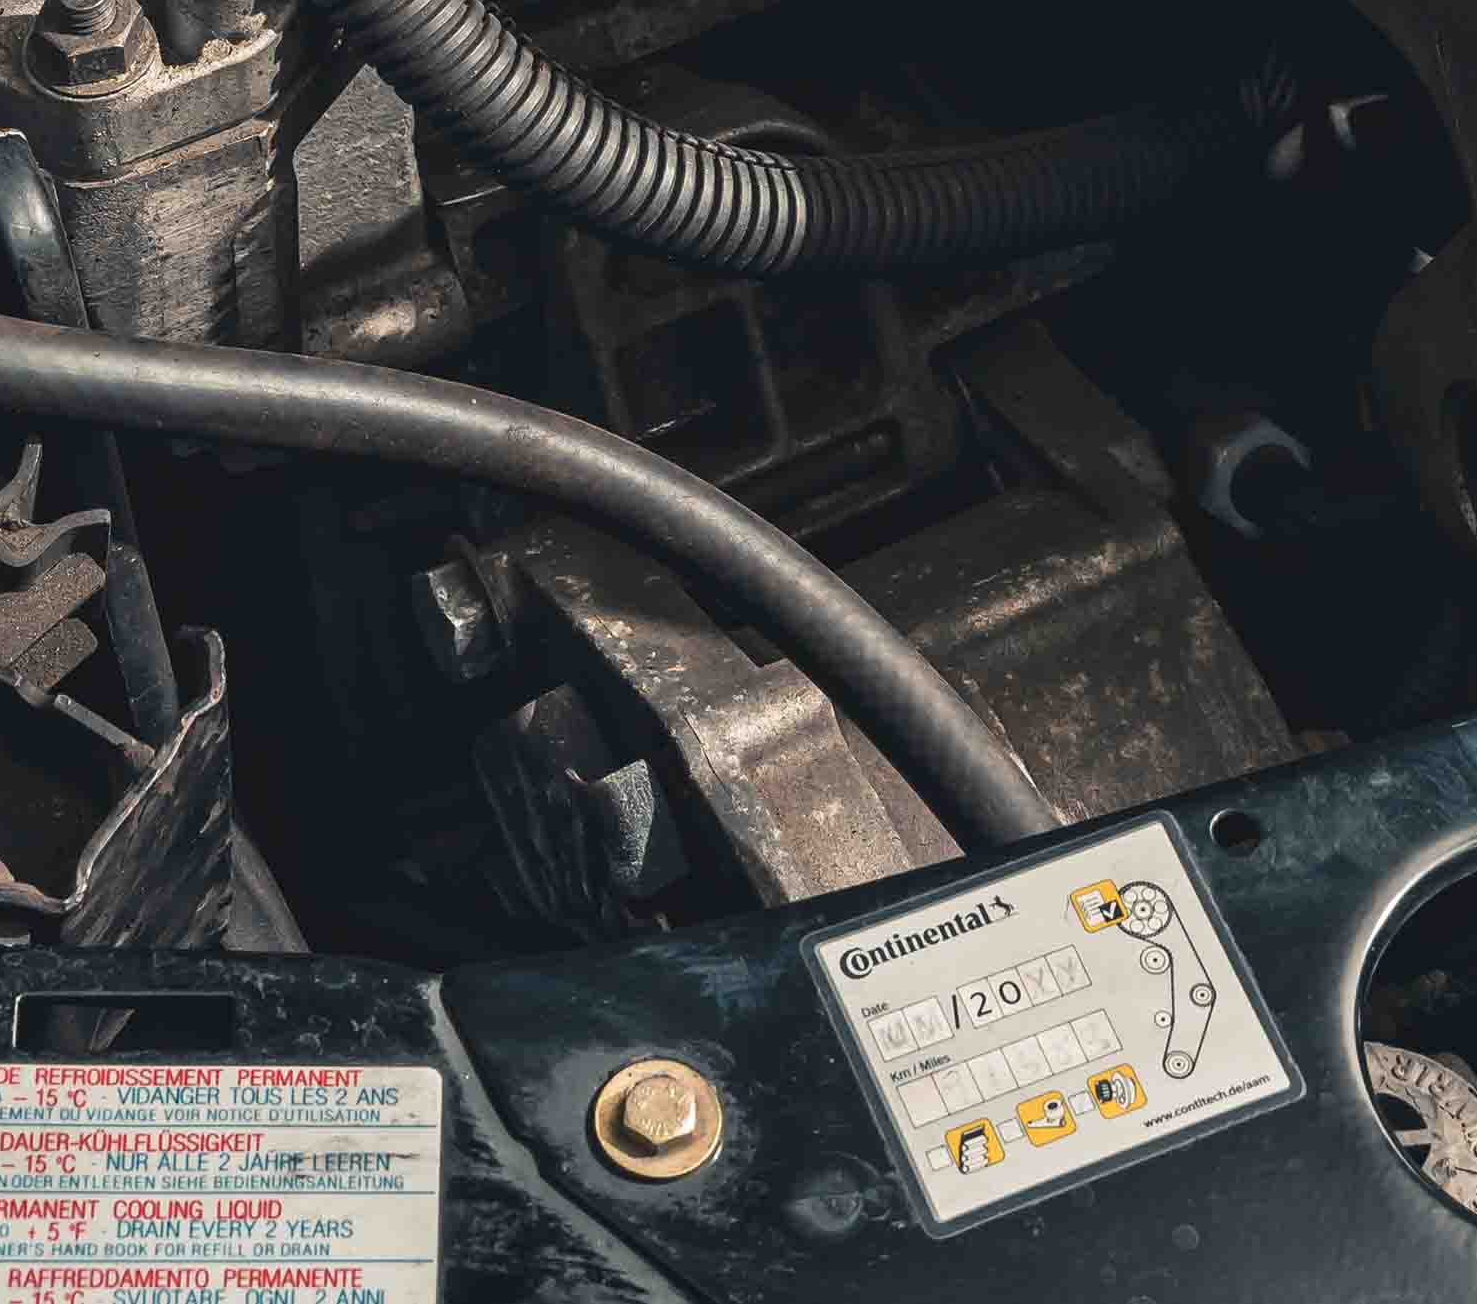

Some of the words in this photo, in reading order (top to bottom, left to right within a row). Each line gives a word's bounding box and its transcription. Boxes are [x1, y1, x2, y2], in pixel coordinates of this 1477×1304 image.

[839, 904, 991, 980] Continental
[861, 1000, 890, 1019] Date
[36, 1068, 221, 1085] REFROIDISSEMENT
[237, 1069, 362, 1086] PERMANENT
[890, 1065, 912, 1083] Km
[918, 1052, 951, 1073] Miles
[36, 1091, 57, 1106] 15
[118, 1087, 219, 1105] VIDANGER
[231, 1087, 282, 1104] TOUS
[292, 1088, 327, 1105] LES
[335, 1089, 346, 1105] 2
[356, 1089, 398, 1105] ANS
[87, 1109, 157, 1121] VIDANGE
[164, 1109, 200, 1121] VOIR
[207, 1109, 263, 1121] NOTICE
[269, 1109, 380, 1122] D'UTILISATION
[0, 1129, 264, 1152] DAUER-KÜHLFLÜSSIGKEIT
[24, 1156, 46, 1173] 15
[107, 1154, 150, 1172] NUR
[158, 1154, 209, 1172] ALLE
[219, 1154, 229, 1172] 2
[239, 1154, 304, 1172] JAHRE
[312, 1154, 390, 1172] LEEREN
[13, 1174, 54, 1188] ODER
[59, 1174, 155, 1189] ENTLEEREN
[161, 1175, 209, 1189] SIEHE
[214, 1175, 404, 1189] BEDIENUNGSANLEITUNG
[114, 1200, 203, 1220] COOLING
[216, 1200, 282, 1220] LIQUID
[47, 1224, 59, 1241] 5
[117, 1221, 180, 1238] DRAIN
[189, 1221, 255, 1238] EVERY
[266, 1222, 276, 1238] 2
[288, 1221, 354, 1238] YEARS
[51, 1244, 97, 1257] HAND
[104, 1244, 146, 1257] BOOK
[155, 1244, 185, 1257] FOR
[191, 1244, 247, 1257] REFILL
[253, 1244, 275, 1257] OR
[281, 1244, 331, 1257] DRAIN
[8, 1268, 209, 1288] RAFFREDDAMENTO
[224, 1269, 363, 1288] PERMANENTE
